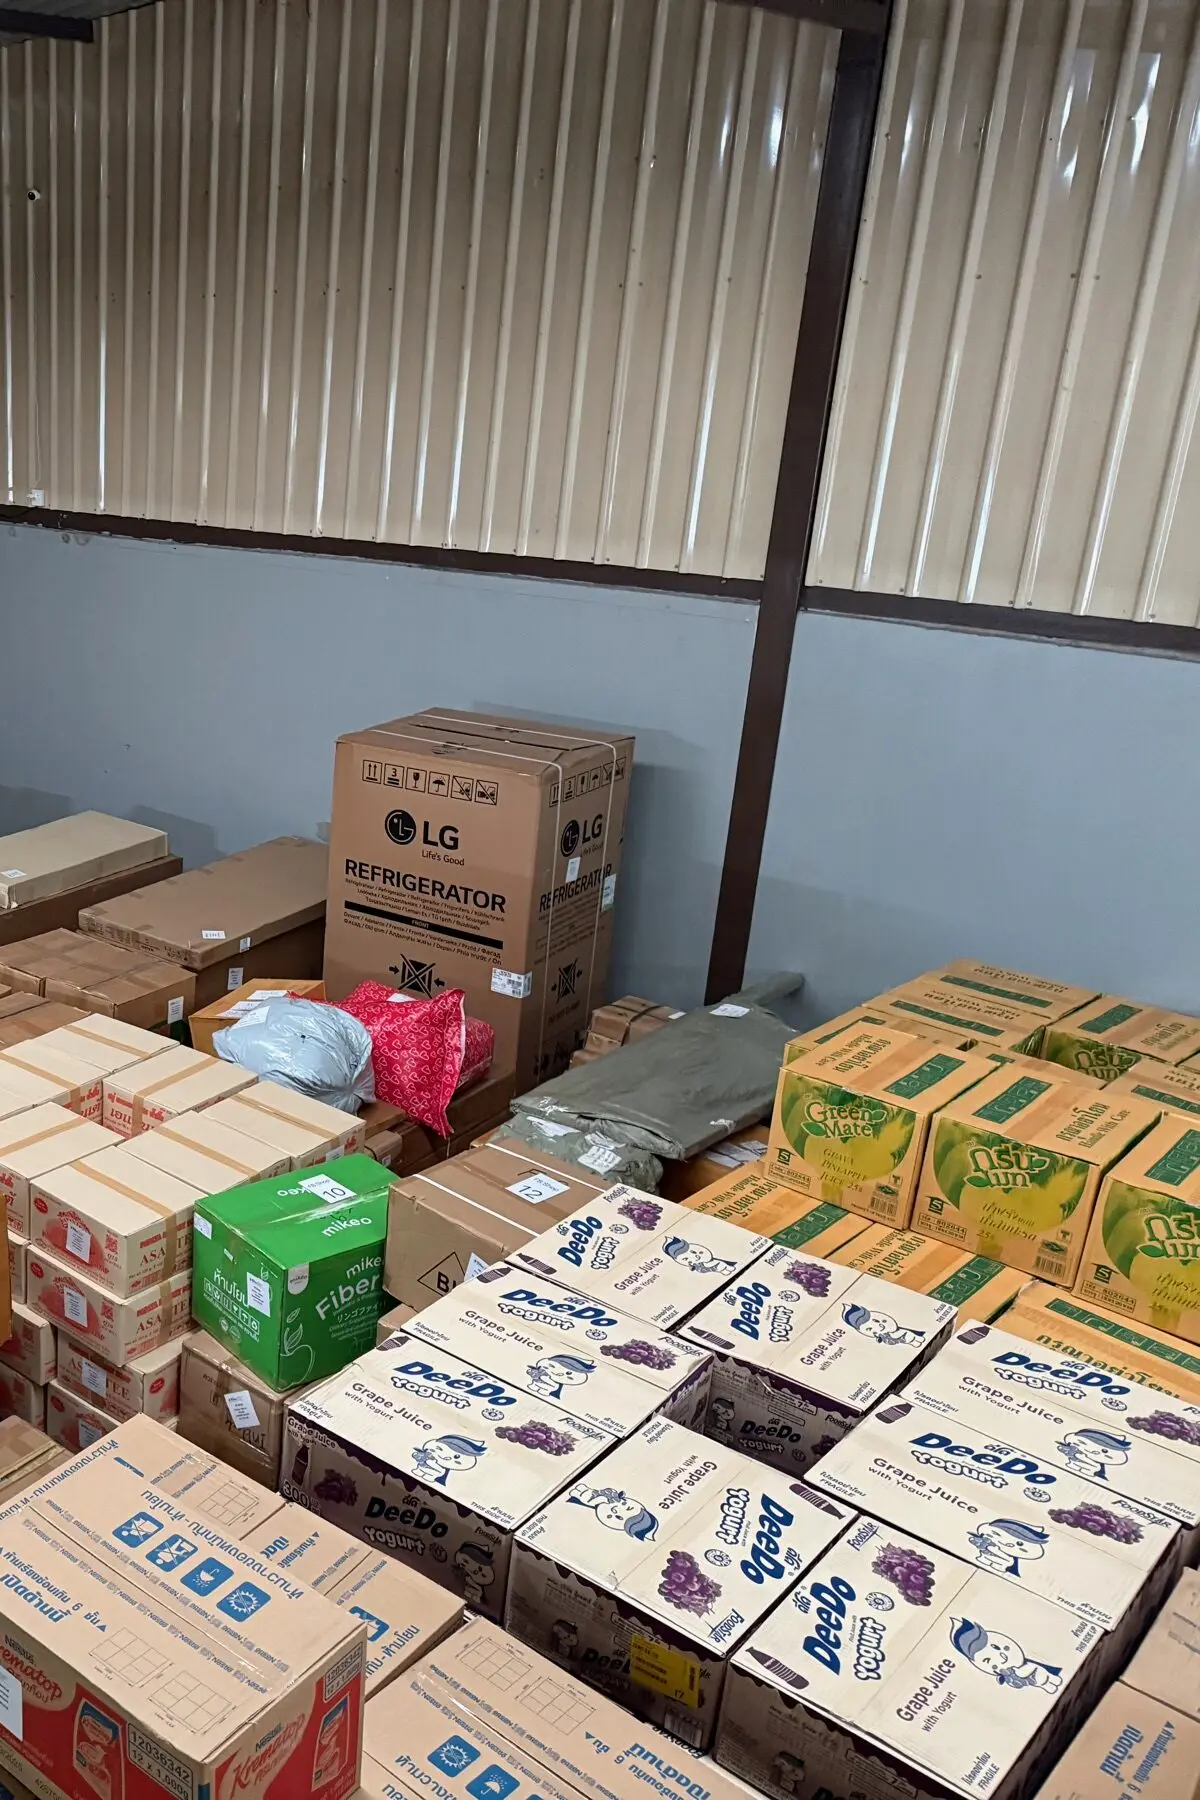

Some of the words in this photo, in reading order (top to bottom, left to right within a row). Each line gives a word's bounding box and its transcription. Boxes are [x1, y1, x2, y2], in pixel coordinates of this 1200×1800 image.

[422, 820, 460, 850] LG
[582, 815, 604, 844] LG
[421, 850, 442, 861] Life's
[443, 854, 465, 866] Good
[345, 859, 507, 913] REFRIGERATOR
[540, 863, 612, 913] REFRIGERATOR
[805, 1101, 875, 1124] Green
[824, 1120, 872, 1139] Mate
[970, 1144, 1034, 1173] กรีน
[322, 1186, 347, 1200] 10
[515, 1185, 544, 1200] 12
[321, 1215, 373, 1237] mikeo
[557, 1215, 603, 1267] DeeDo
[591, 1236, 620, 1270] Yogurt
[614, 1270, 642, 1292] Grape
[639, 1256, 664, 1280] Juice
[631, 1284, 644, 1296] with
[640, 1274, 660, 1290] Yogurt
[315, 1274, 381, 1321] Fiber
[499, 1289, 618, 1328] DeeDo
[730, 1282, 772, 1341] DeeDo
[458, 1317, 478, 1329] with
[479, 1326, 508, 1343] Yogurt
[465, 1310, 505, 1334] Grape
[506, 1328, 544, 1352] Juice
[498, 1302, 575, 1331] Yogurt
[662, 1311, 679, 1325] FRAGILE
[769, 1305, 795, 1343] Yogurt
[413, 1327, 442, 1343] FRAGILE
[800, 1344, 828, 1367] Grape
[825, 1327, 847, 1353] Juice
[819, 1359, 833, 1371] with
[829, 1345, 848, 1364] Yogurt
[990, 1351, 1131, 1396] DeeDo
[390, 1375, 472, 1410] Yogurt
[394, 1361, 517, 1407] DeeDo
[859, 1387, 877, 1404] FRAGILE
[993, 1366, 1088, 1400] Yogurt
[298, 1403, 327, 1421] FRAGILE
[344, 1390, 367, 1404] with
[365, 1400, 394, 1421] Yogurt
[352, 1382, 395, 1410] Grape
[395, 1405, 433, 1431] Juice
[912, 1396, 950, 1414] FRAGILE
[958, 1384, 982, 1398] with
[983, 1394, 1021, 1415] Yogurt
[962, 1376, 1014, 1403] Grape
[1015, 1399, 1065, 1425] Juice
[642, 1420, 662, 1438] FRAGILE
[740, 1420, 802, 1443] DeeDo
[681, 1454, 698, 1470] with
[684, 1460, 718, 1488] Grape
[908, 1432, 1057, 1485] DeeDo
[910, 1450, 1009, 1490] Yogurt
[663, 1464, 687, 1485] Yogurt
[819, 1477, 857, 1499] FRAGILE
[868, 1465, 893, 1481] with
[895, 1477, 933, 1503] Yogurt
[873, 1457, 926, 1490] Grape
[929, 1485, 979, 1516] Juice
[283, 1480, 309, 1505] 300
[658, 1483, 690, 1511] Juice
[365, 1496, 449, 1539] DeeDo
[715, 1488, 750, 1546] Yogurt
[364, 1525, 425, 1556] Yogurt
[740, 1493, 794, 1584] DeeDo
[0, 1571, 72, 1625] เปิดด้านนี้
[71, 1602, 81, 1612] 6
[803, 1575, 857, 1676] DeeDo
[853, 1616, 887, 1681] Yogurt
[896, 1684, 934, 1723] Grape
[929, 1657, 956, 1691] Juice
[921, 1712, 939, 1732] with
[936, 1691, 958, 1718] Yogurt
[129, 1729, 192, 1784] 12036342
[978, 1763, 1001, 1791] FRAGILE
